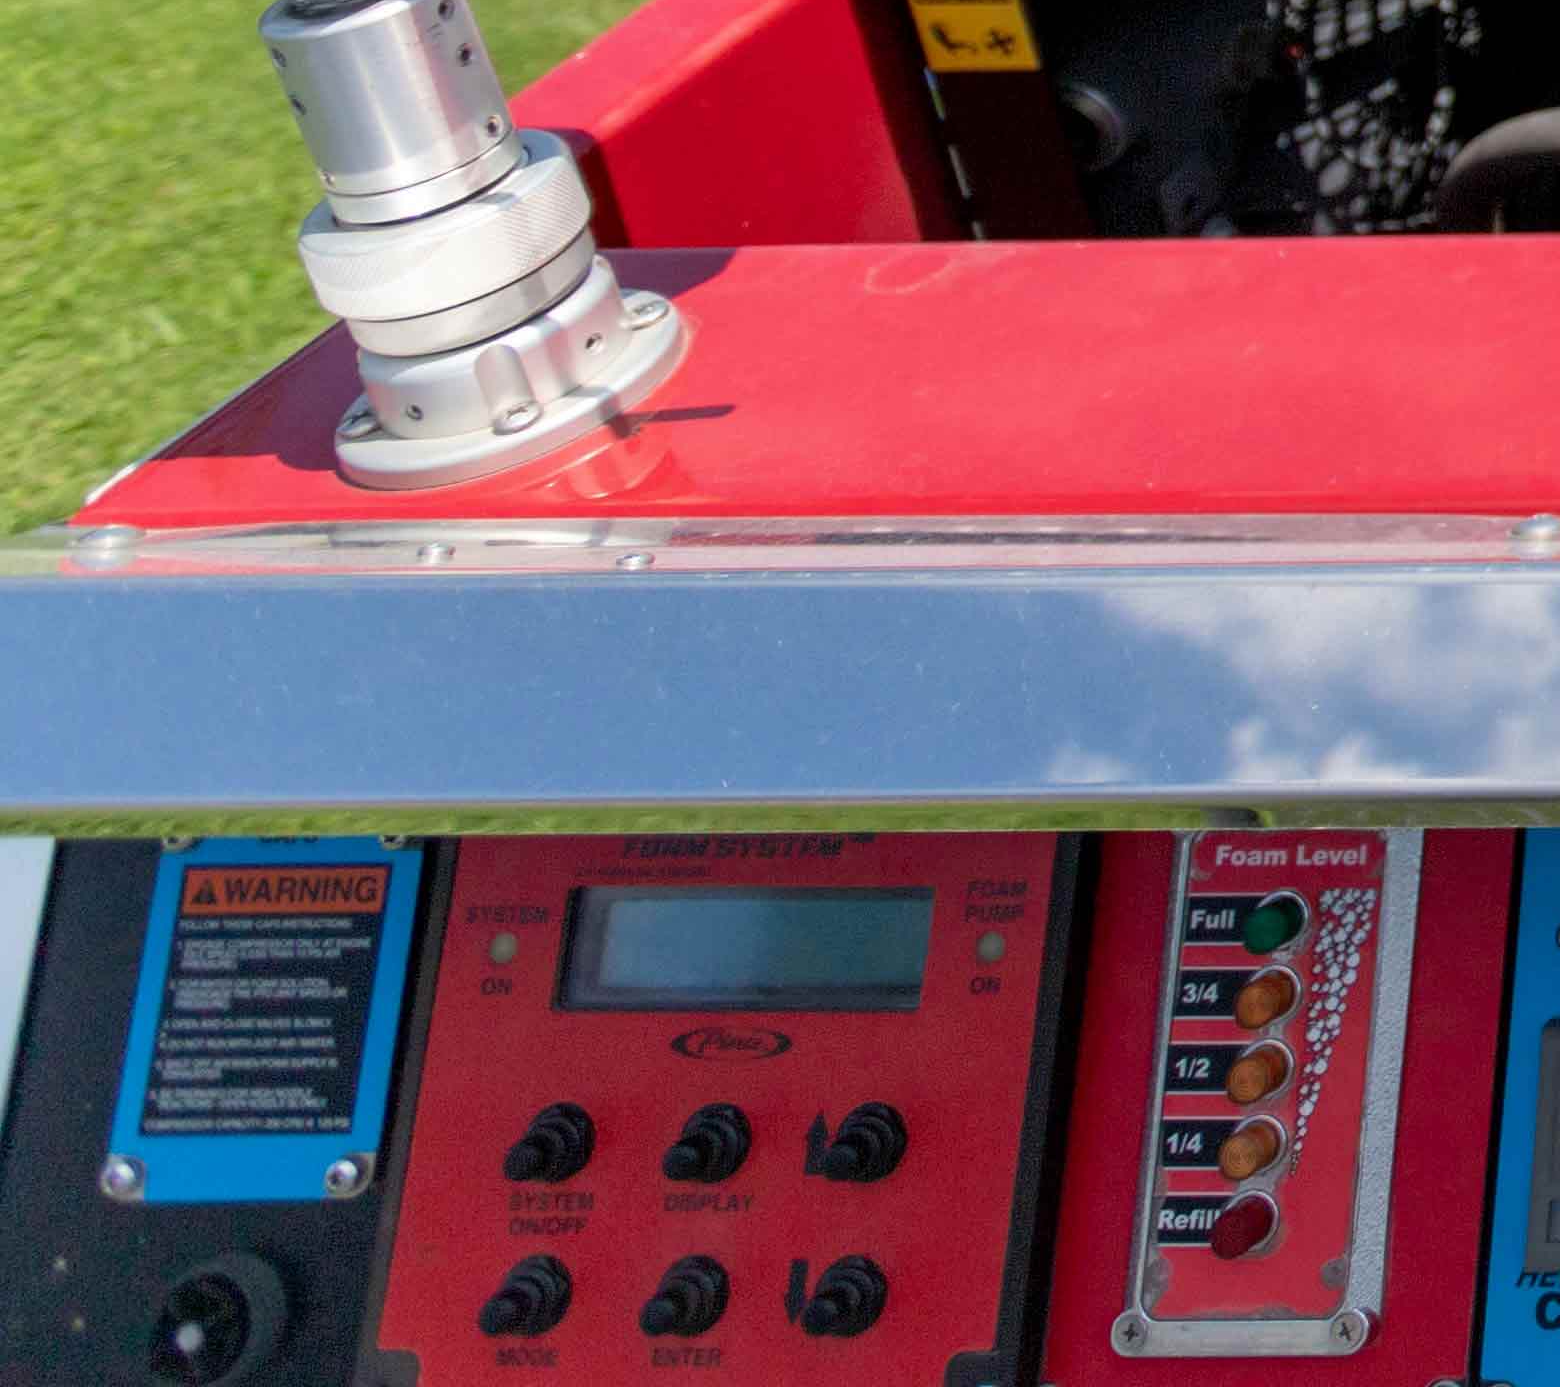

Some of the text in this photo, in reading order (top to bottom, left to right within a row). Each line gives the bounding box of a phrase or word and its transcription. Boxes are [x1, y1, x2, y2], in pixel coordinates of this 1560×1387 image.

[1216, 845, 1367, 866] Foam Level
[224, 876, 377, 903] WARNING
[1190, 909, 1235, 929] Full
[1181, 983, 1218, 1003] 3/4
[1175, 1058, 1211, 1078] 1/2
[1167, 1132, 1202, 1153] 1/4
[652, 1348, 720, 1367] ENTER
